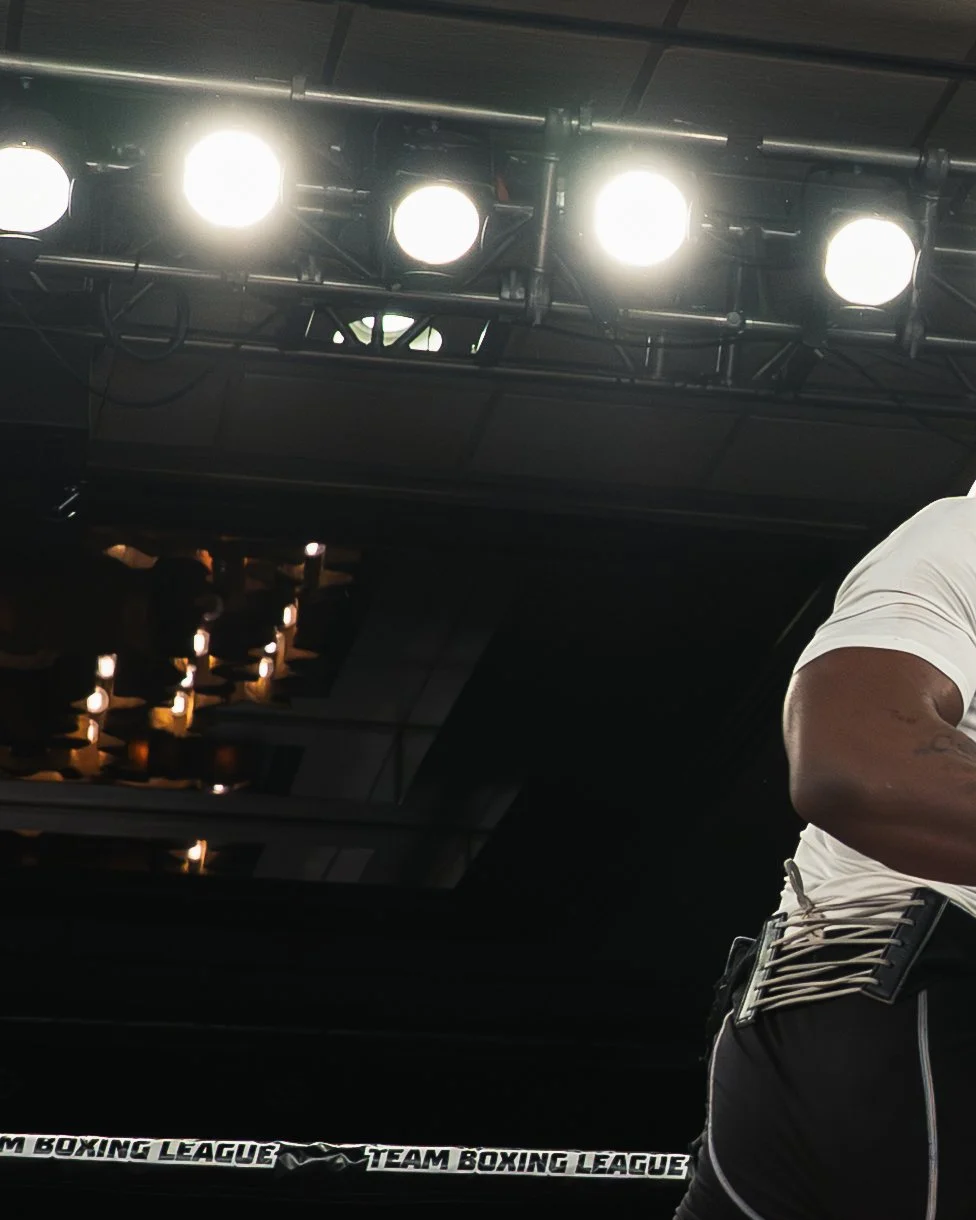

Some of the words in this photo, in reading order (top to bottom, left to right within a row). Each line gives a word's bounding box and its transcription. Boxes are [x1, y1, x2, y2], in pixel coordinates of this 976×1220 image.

[34, 1137, 150, 1159] BOXING
[159, 1141, 280, 1165] LEAGUE
[369, 1148, 449, 1170] TEAM
[457, 1150, 567, 1173] BOXING
[575, 1153, 688, 1176] LEAGUE
